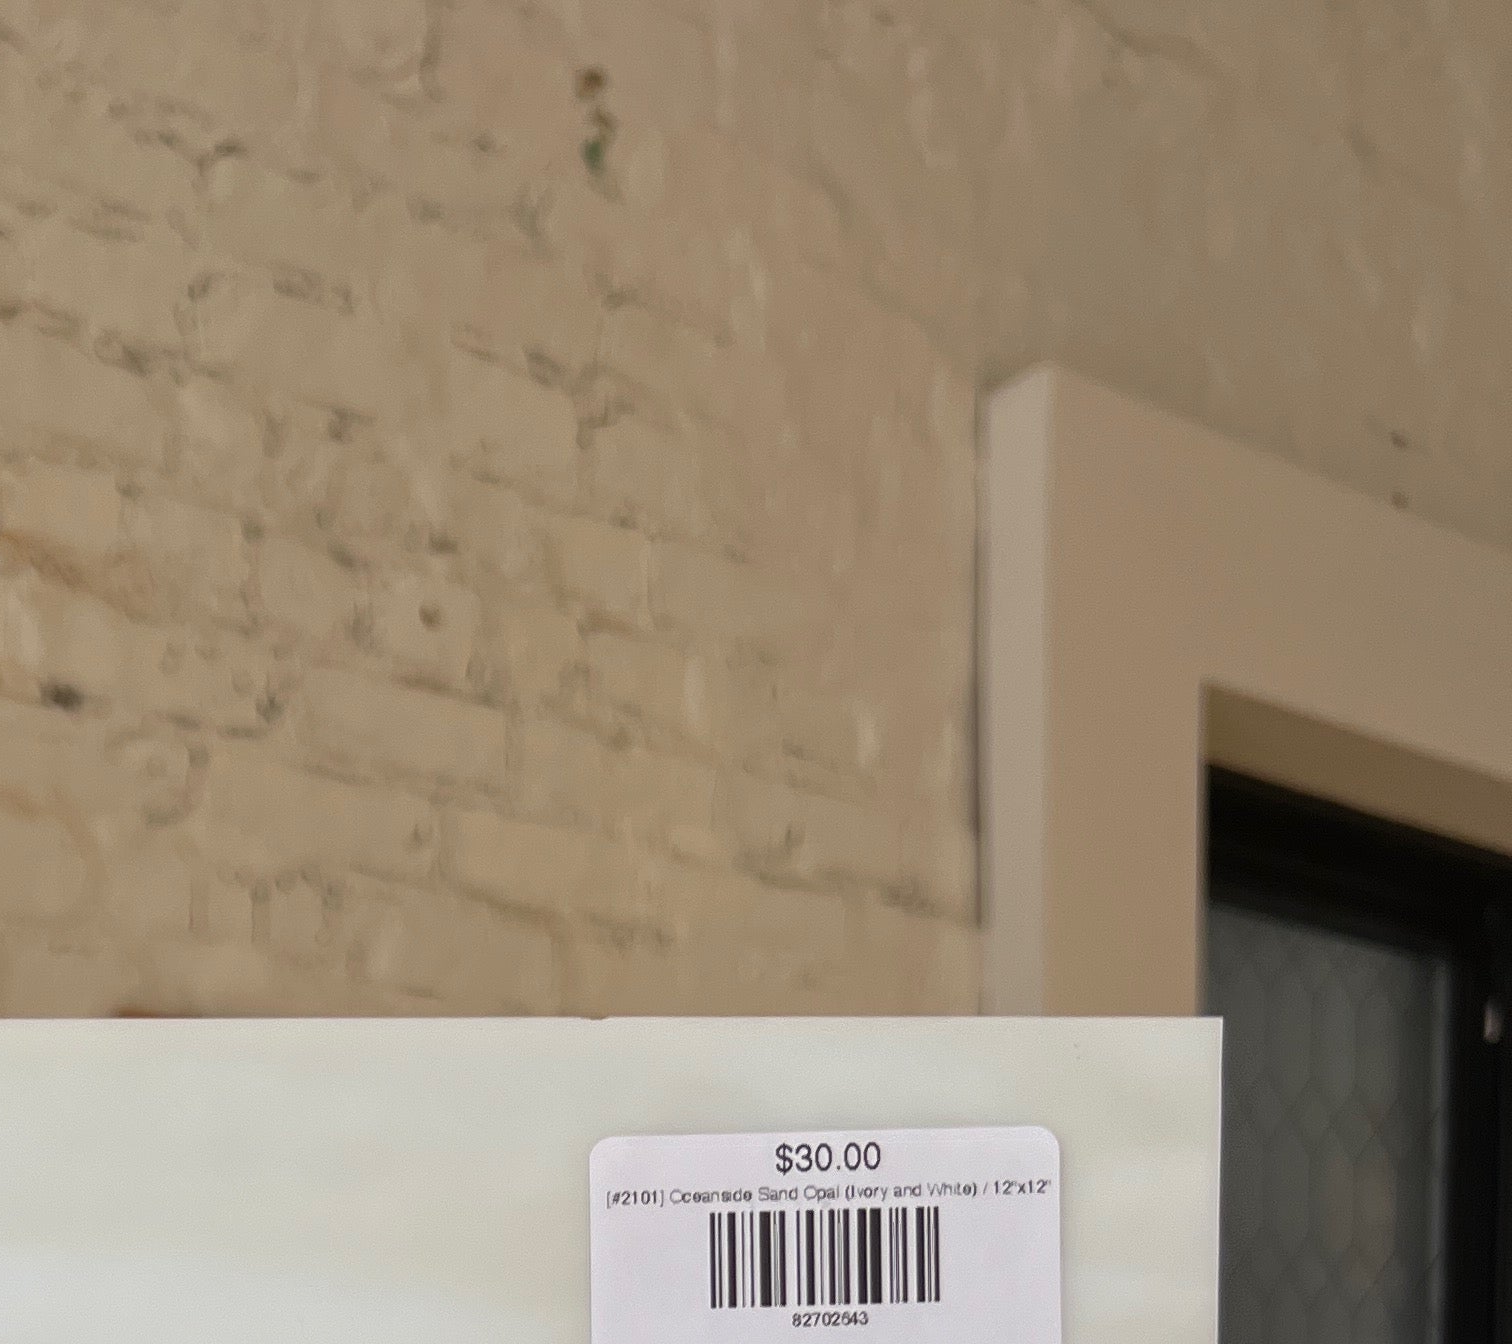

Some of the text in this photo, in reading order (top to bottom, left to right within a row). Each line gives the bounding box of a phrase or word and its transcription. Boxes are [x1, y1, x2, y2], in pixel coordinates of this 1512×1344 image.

[775, 1142, 881, 1176] $30.00
[606, 1189, 664, 1209] [#2101]
[669, 1187, 752, 1205] Oceanside
[758, 1186, 798, 1202] Sand
[803, 1184, 840, 1203] Opal
[845, 1184, 888, 1202] (Ivory
[893, 1183, 922, 1198] and
[926, 1181, 977, 1198] White)
[982, 1181, 989, 1196] /
[791, 1310, 869, 1328] 82702643
